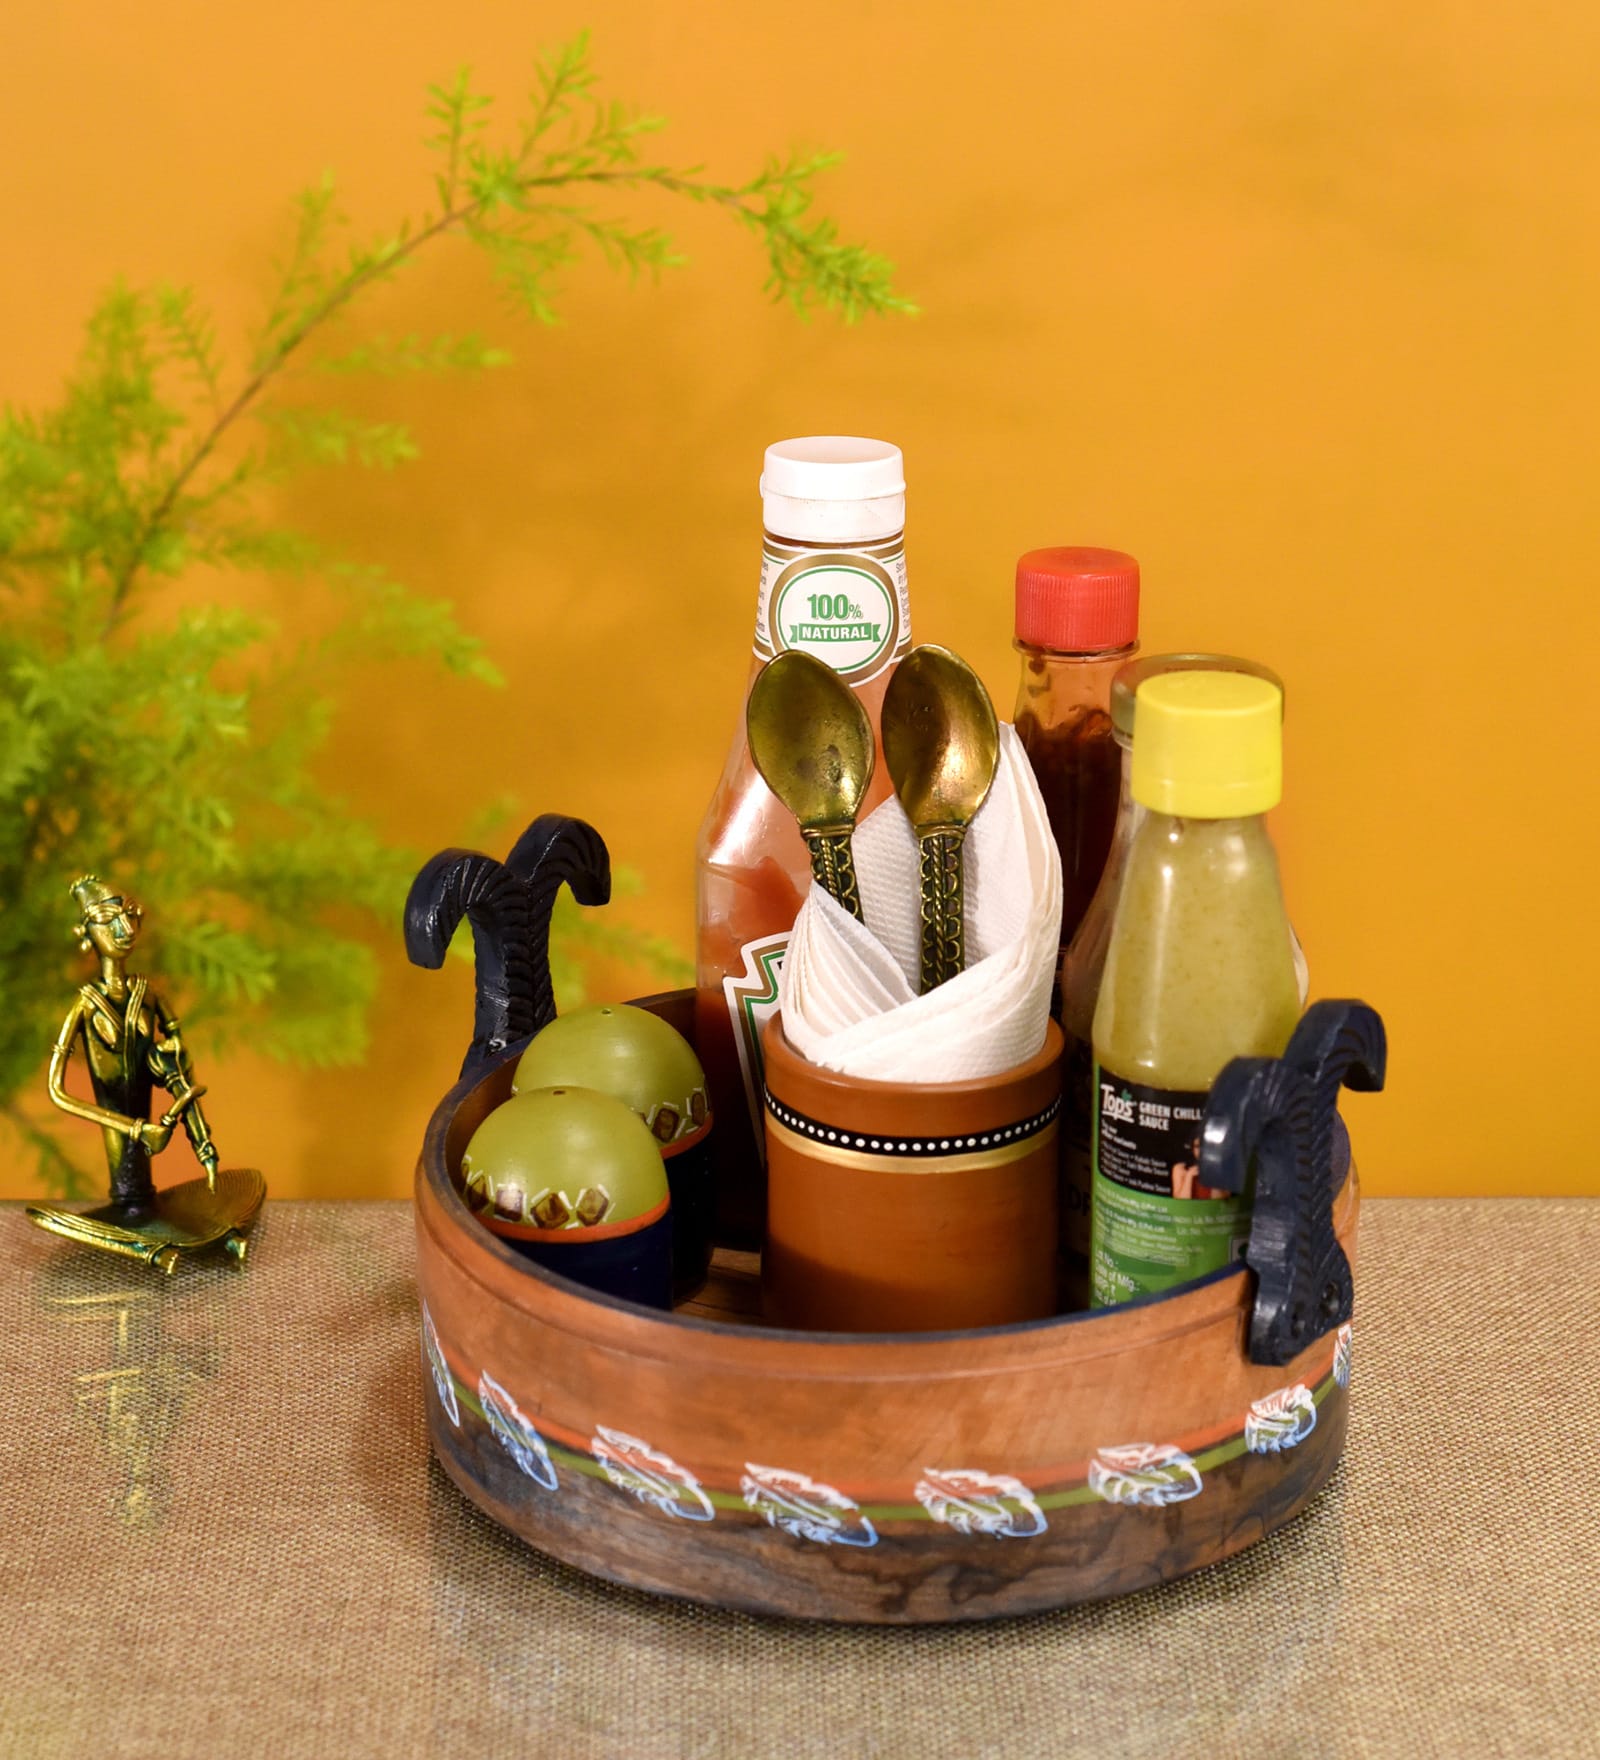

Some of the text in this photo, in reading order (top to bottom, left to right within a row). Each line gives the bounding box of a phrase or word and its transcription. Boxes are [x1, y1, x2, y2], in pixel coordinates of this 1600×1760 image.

[807, 594, 863, 620] 100%
[802, 626, 868, 640] NATURAL
[1100, 1083, 1134, 1121] Tops
[1139, 1101, 1204, 1121] GREEN CHILL
[1139, 1114, 1169, 1131] SAUCE
